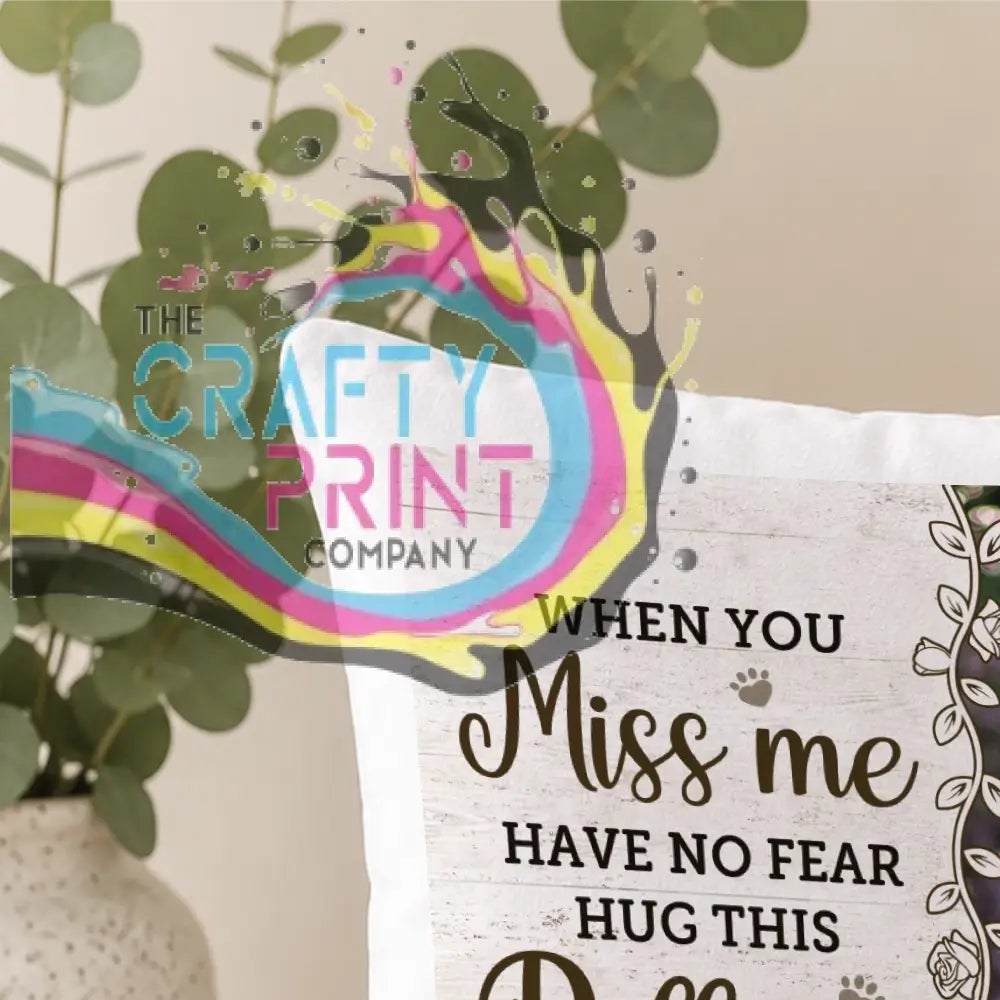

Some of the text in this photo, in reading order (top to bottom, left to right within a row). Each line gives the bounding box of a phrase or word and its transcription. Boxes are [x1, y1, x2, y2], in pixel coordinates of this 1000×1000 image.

[534, 593, 845, 654] WHEN YOU
[459, 643, 919, 808] Miss me
[502, 821, 905, 888] HAVE NO FEAR
[574, 896, 841, 953] HUG THIS
